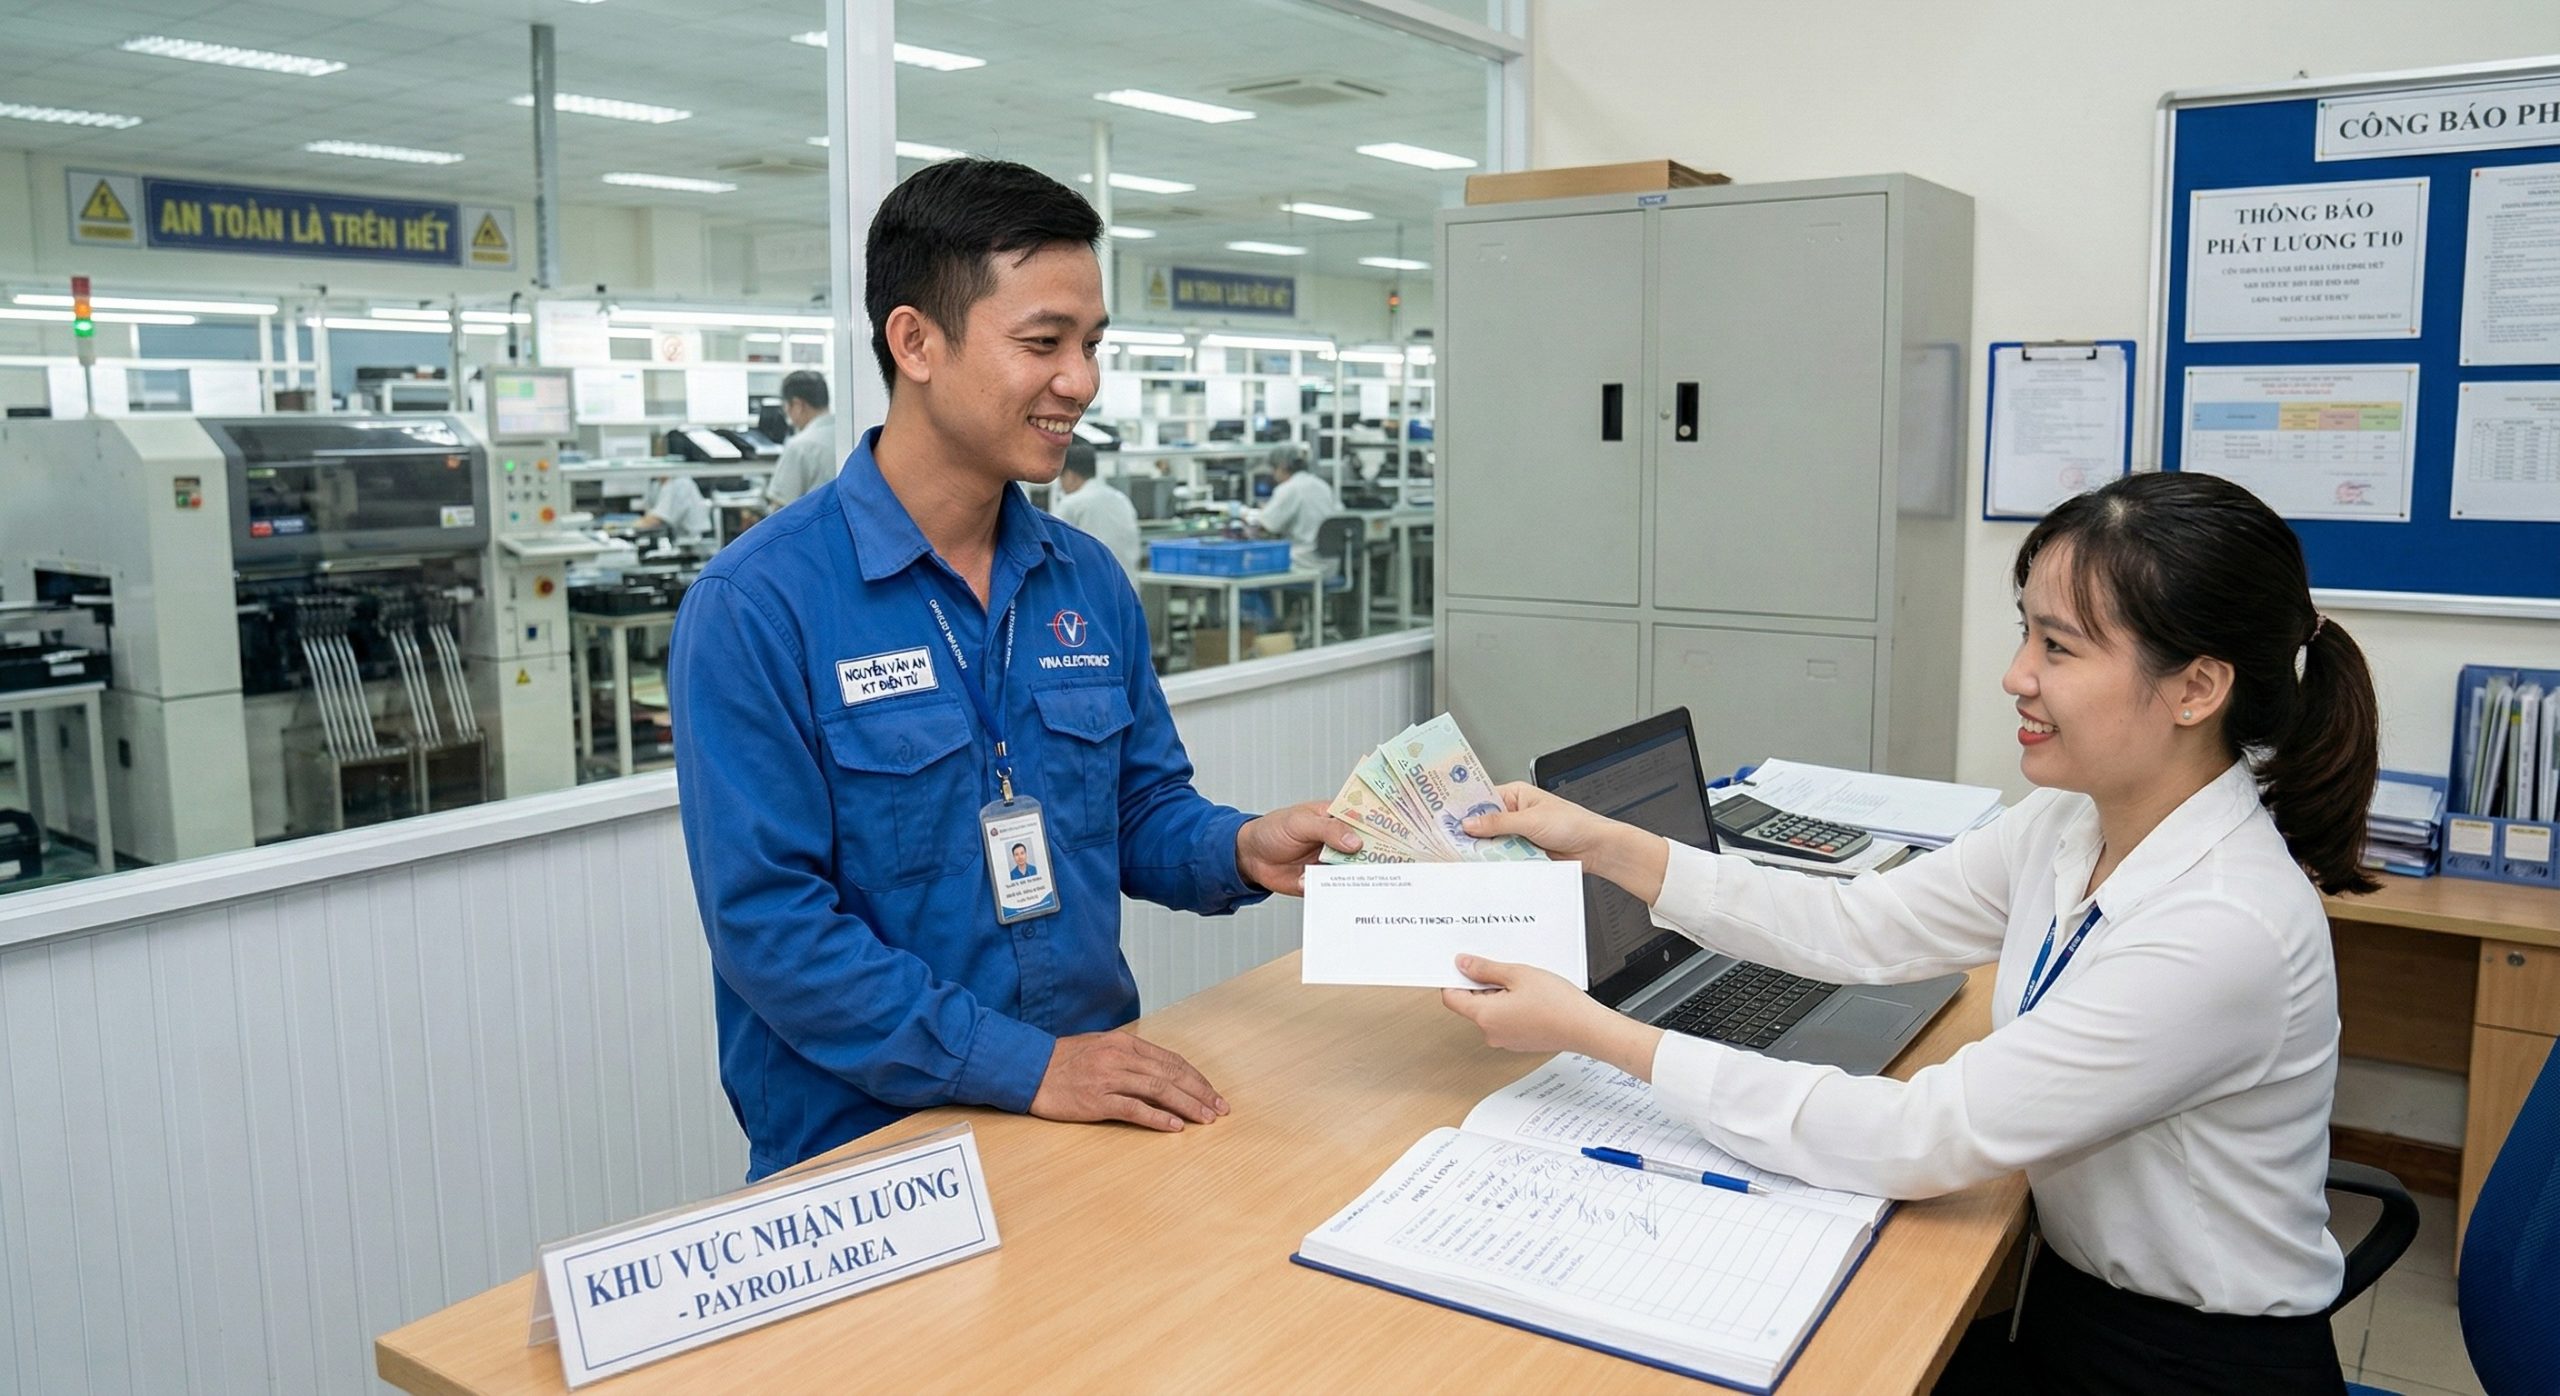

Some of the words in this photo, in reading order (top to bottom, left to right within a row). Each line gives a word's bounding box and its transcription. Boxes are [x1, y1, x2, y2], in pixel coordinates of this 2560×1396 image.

[2339, 111, 2429, 140] CÔNG
[2439, 102, 2507, 132] BÁO
[161, 198, 202, 235] AN
[208, 198, 284, 241] TOÀN
[291, 203, 325, 245] LÀ
[330, 208, 397, 249] TRÊN
[404, 211, 448, 252] HẾT
[2235, 203, 2317, 225] THÔNG
[2325, 198, 2374, 220] BÁO
[2207, 233, 2266, 254] PHÁT
[2273, 233, 2356, 252] LƯƠNG
[2364, 231, 2404, 248] T10
[912, 656, 927, 669] AN
[1038, 655, 1063, 669] VINA
[861, 681, 876, 695] KT
[1409, 763, 1444, 812] 50000
[584, 1254, 663, 1308] KHU
[670, 1231, 746, 1280] VỰC
[751, 1201, 844, 1257] NHẬN
[850, 1168, 960, 1227] LƯƠNG
[694, 1259, 822, 1320] PAYROLL
[828, 1235, 898, 1277] AREA
